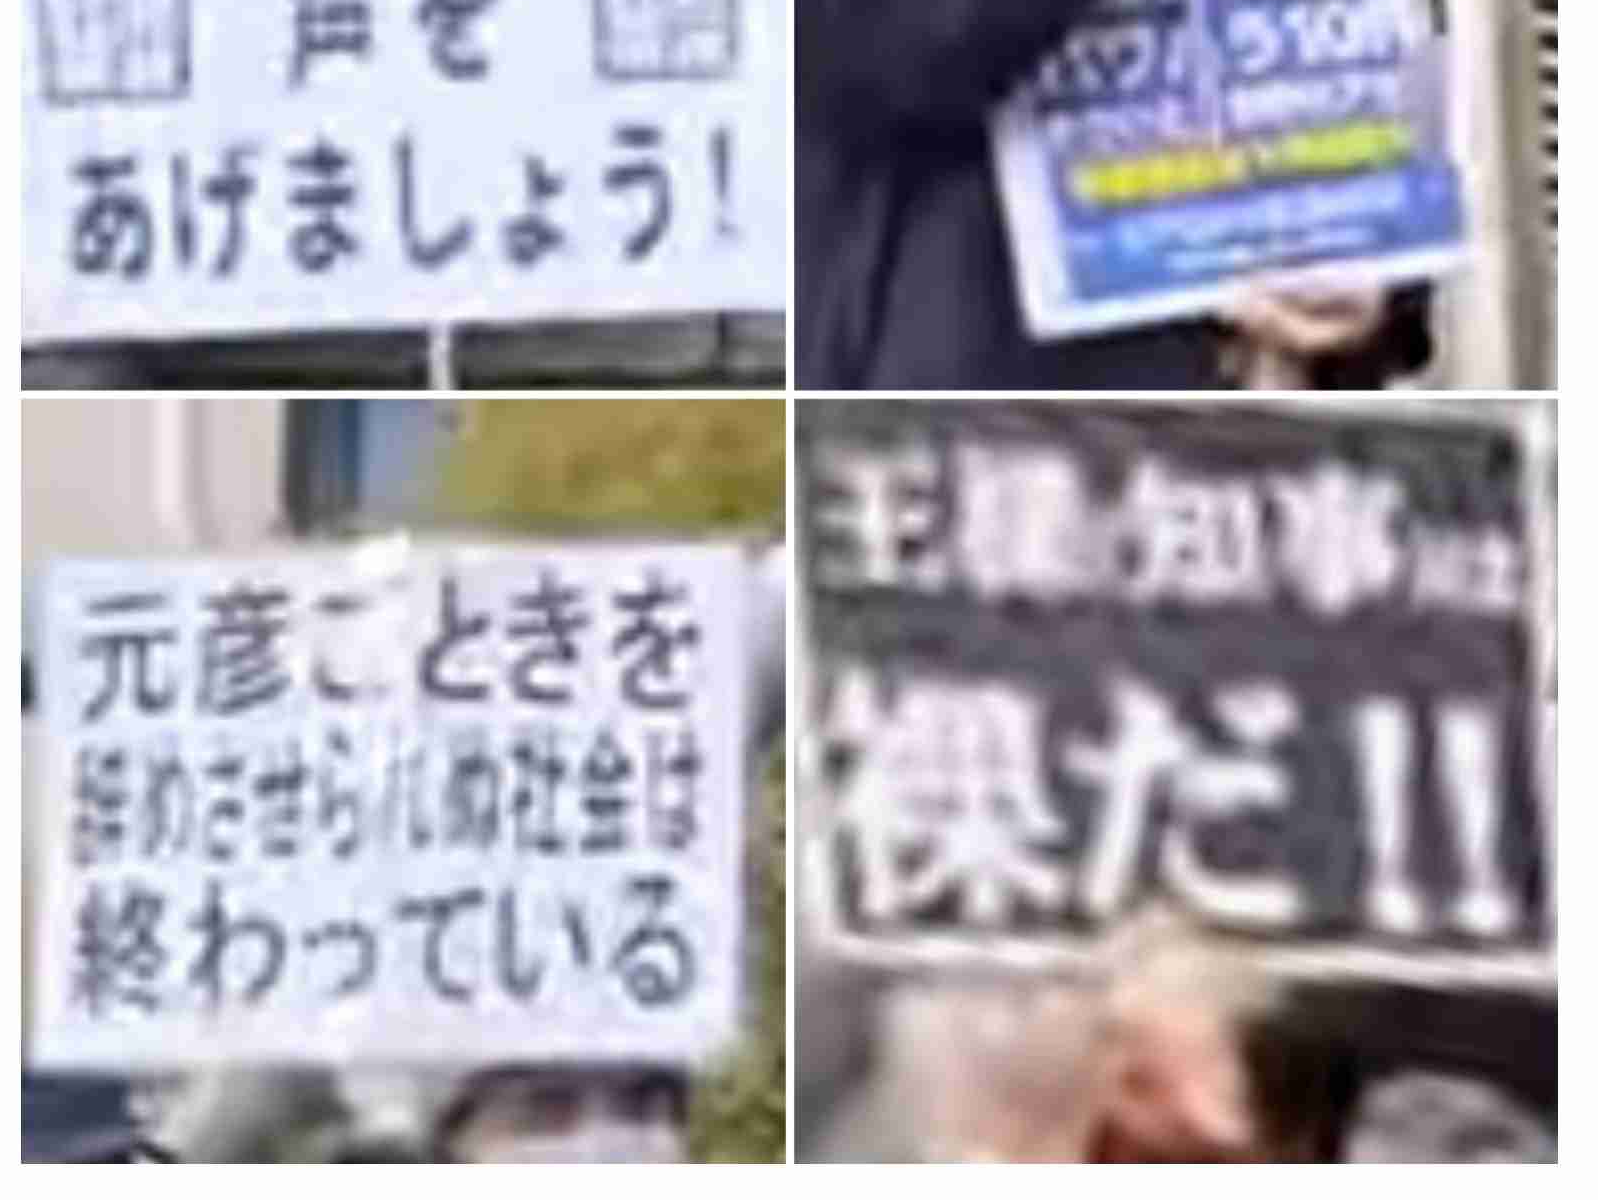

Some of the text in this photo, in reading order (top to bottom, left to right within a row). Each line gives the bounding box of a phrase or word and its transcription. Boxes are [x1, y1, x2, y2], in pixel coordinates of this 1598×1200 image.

[67, 872, 702, 1016] 終わっている
